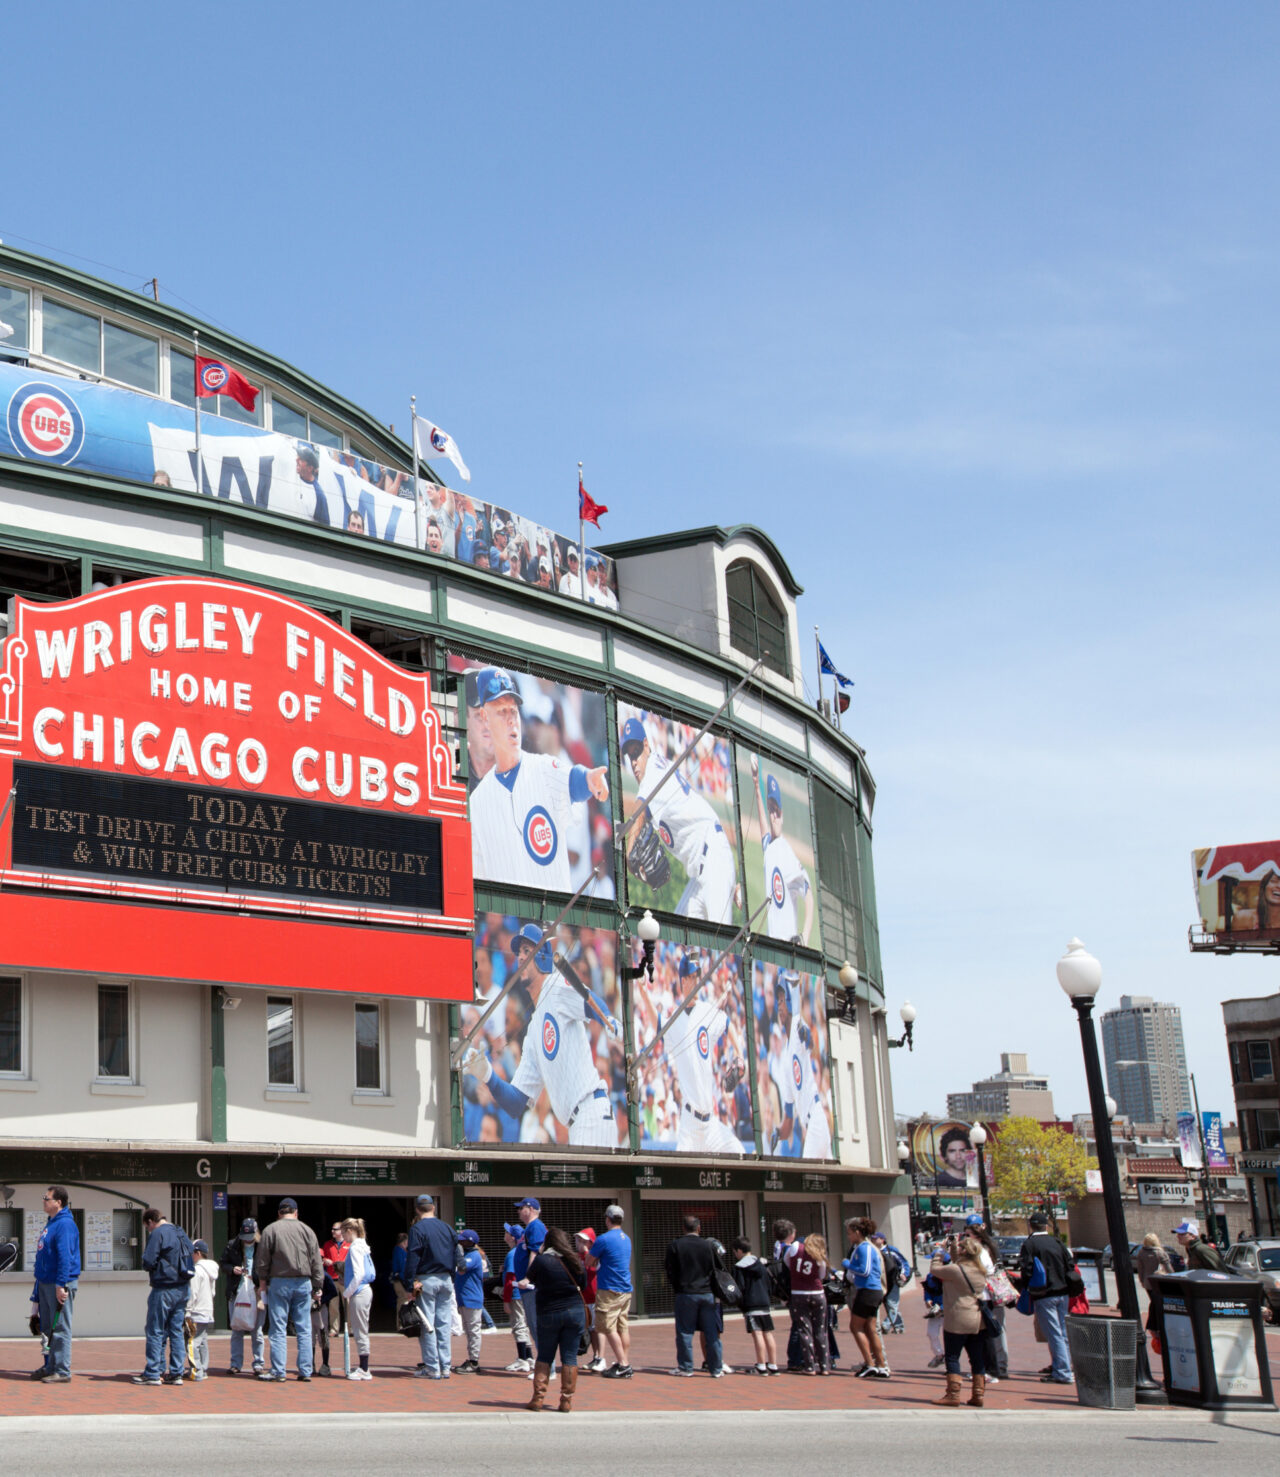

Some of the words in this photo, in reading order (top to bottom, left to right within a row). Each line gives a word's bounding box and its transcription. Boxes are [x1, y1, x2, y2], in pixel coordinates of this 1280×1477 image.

[34, 602, 263, 679] WRIGLEY
[286, 622, 417, 736] FIELD
[150, 668, 253, 713] HOME
[278, 690, 322, 723] OF
[33, 706, 268, 785] CHICAGO
[292, 746, 421, 807] CUBS
[187, 794, 288, 832] TODAY
[25, 805, 90, 835] TEST
[96, 815, 176, 846] DRIVE
[182, 826, 199, 848] A
[205, 828, 285, 858] CHEVY
[291, 840, 322, 863] AT
[328, 843, 430, 876] WRIGLEY
[529, 816, 552, 854] CUBS
[73, 840, 94, 864] &
[101, 843, 155, 871] WIN
[161, 850, 223, 879] FREE
[228, 858, 287, 886] CUBS
[292, 865, 391, 898] TICKETS!
[196, 1158, 211, 1178] G
[453, 1172, 490, 1183] INSPECTION
[465, 1161, 478, 1172] BAG
[699, 1171, 722, 1187] GATE
[725, 1172, 731, 1188] F
[1144, 1184, 1189, 1197] Parking
[796, 1258, 813, 1276] 13
[1211, 1301, 1235, 1309] TRASH
